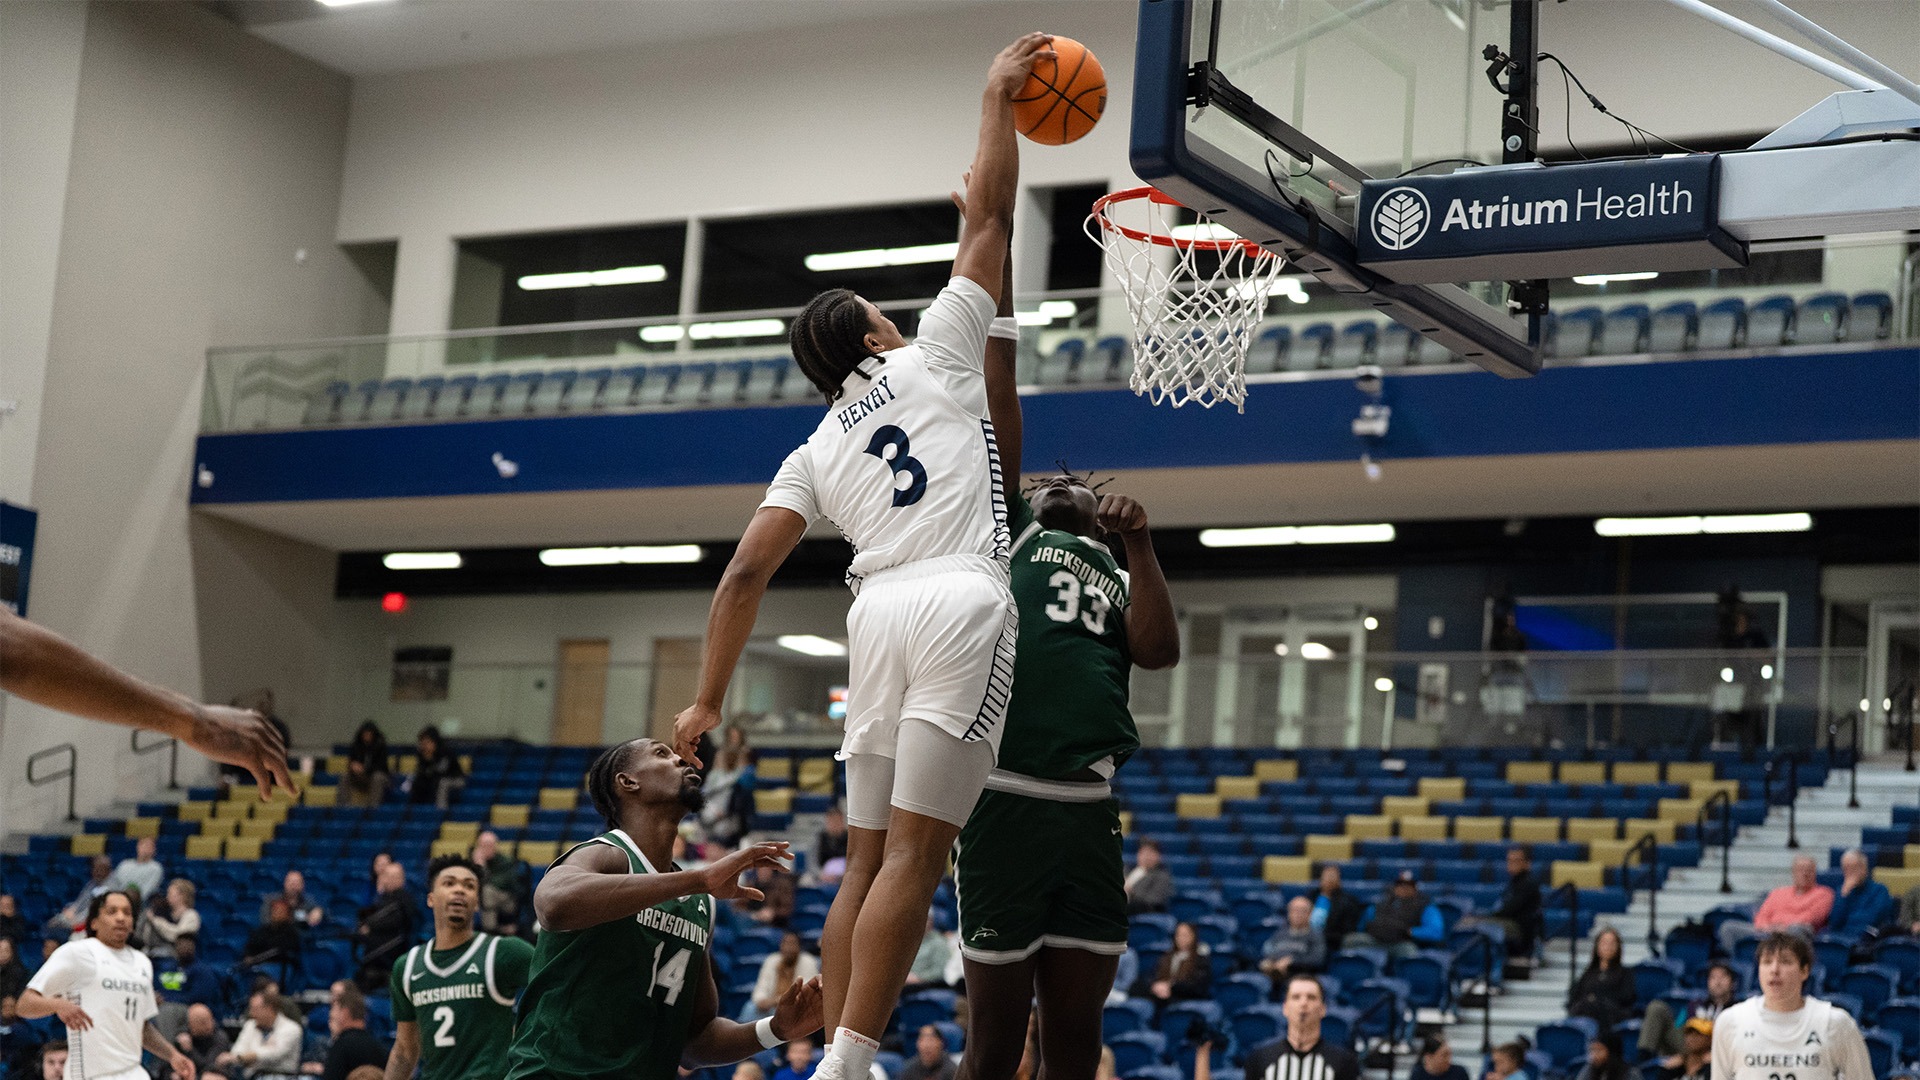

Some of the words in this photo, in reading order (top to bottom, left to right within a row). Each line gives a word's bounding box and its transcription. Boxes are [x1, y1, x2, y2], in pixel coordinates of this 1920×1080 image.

[1440, 195, 1568, 231] Atrium
[1576, 180, 1692, 221] Health
[837, 375, 896, 434] HENRY
[862, 424, 928, 509] 3
[1045, 570, 1111, 635] 33
[646, 940, 692, 1007] 14
[125, 997, 138, 1020] 11
[433, 1006, 456, 1048] 2
[1744, 1053, 1821, 1068] QUEENS
